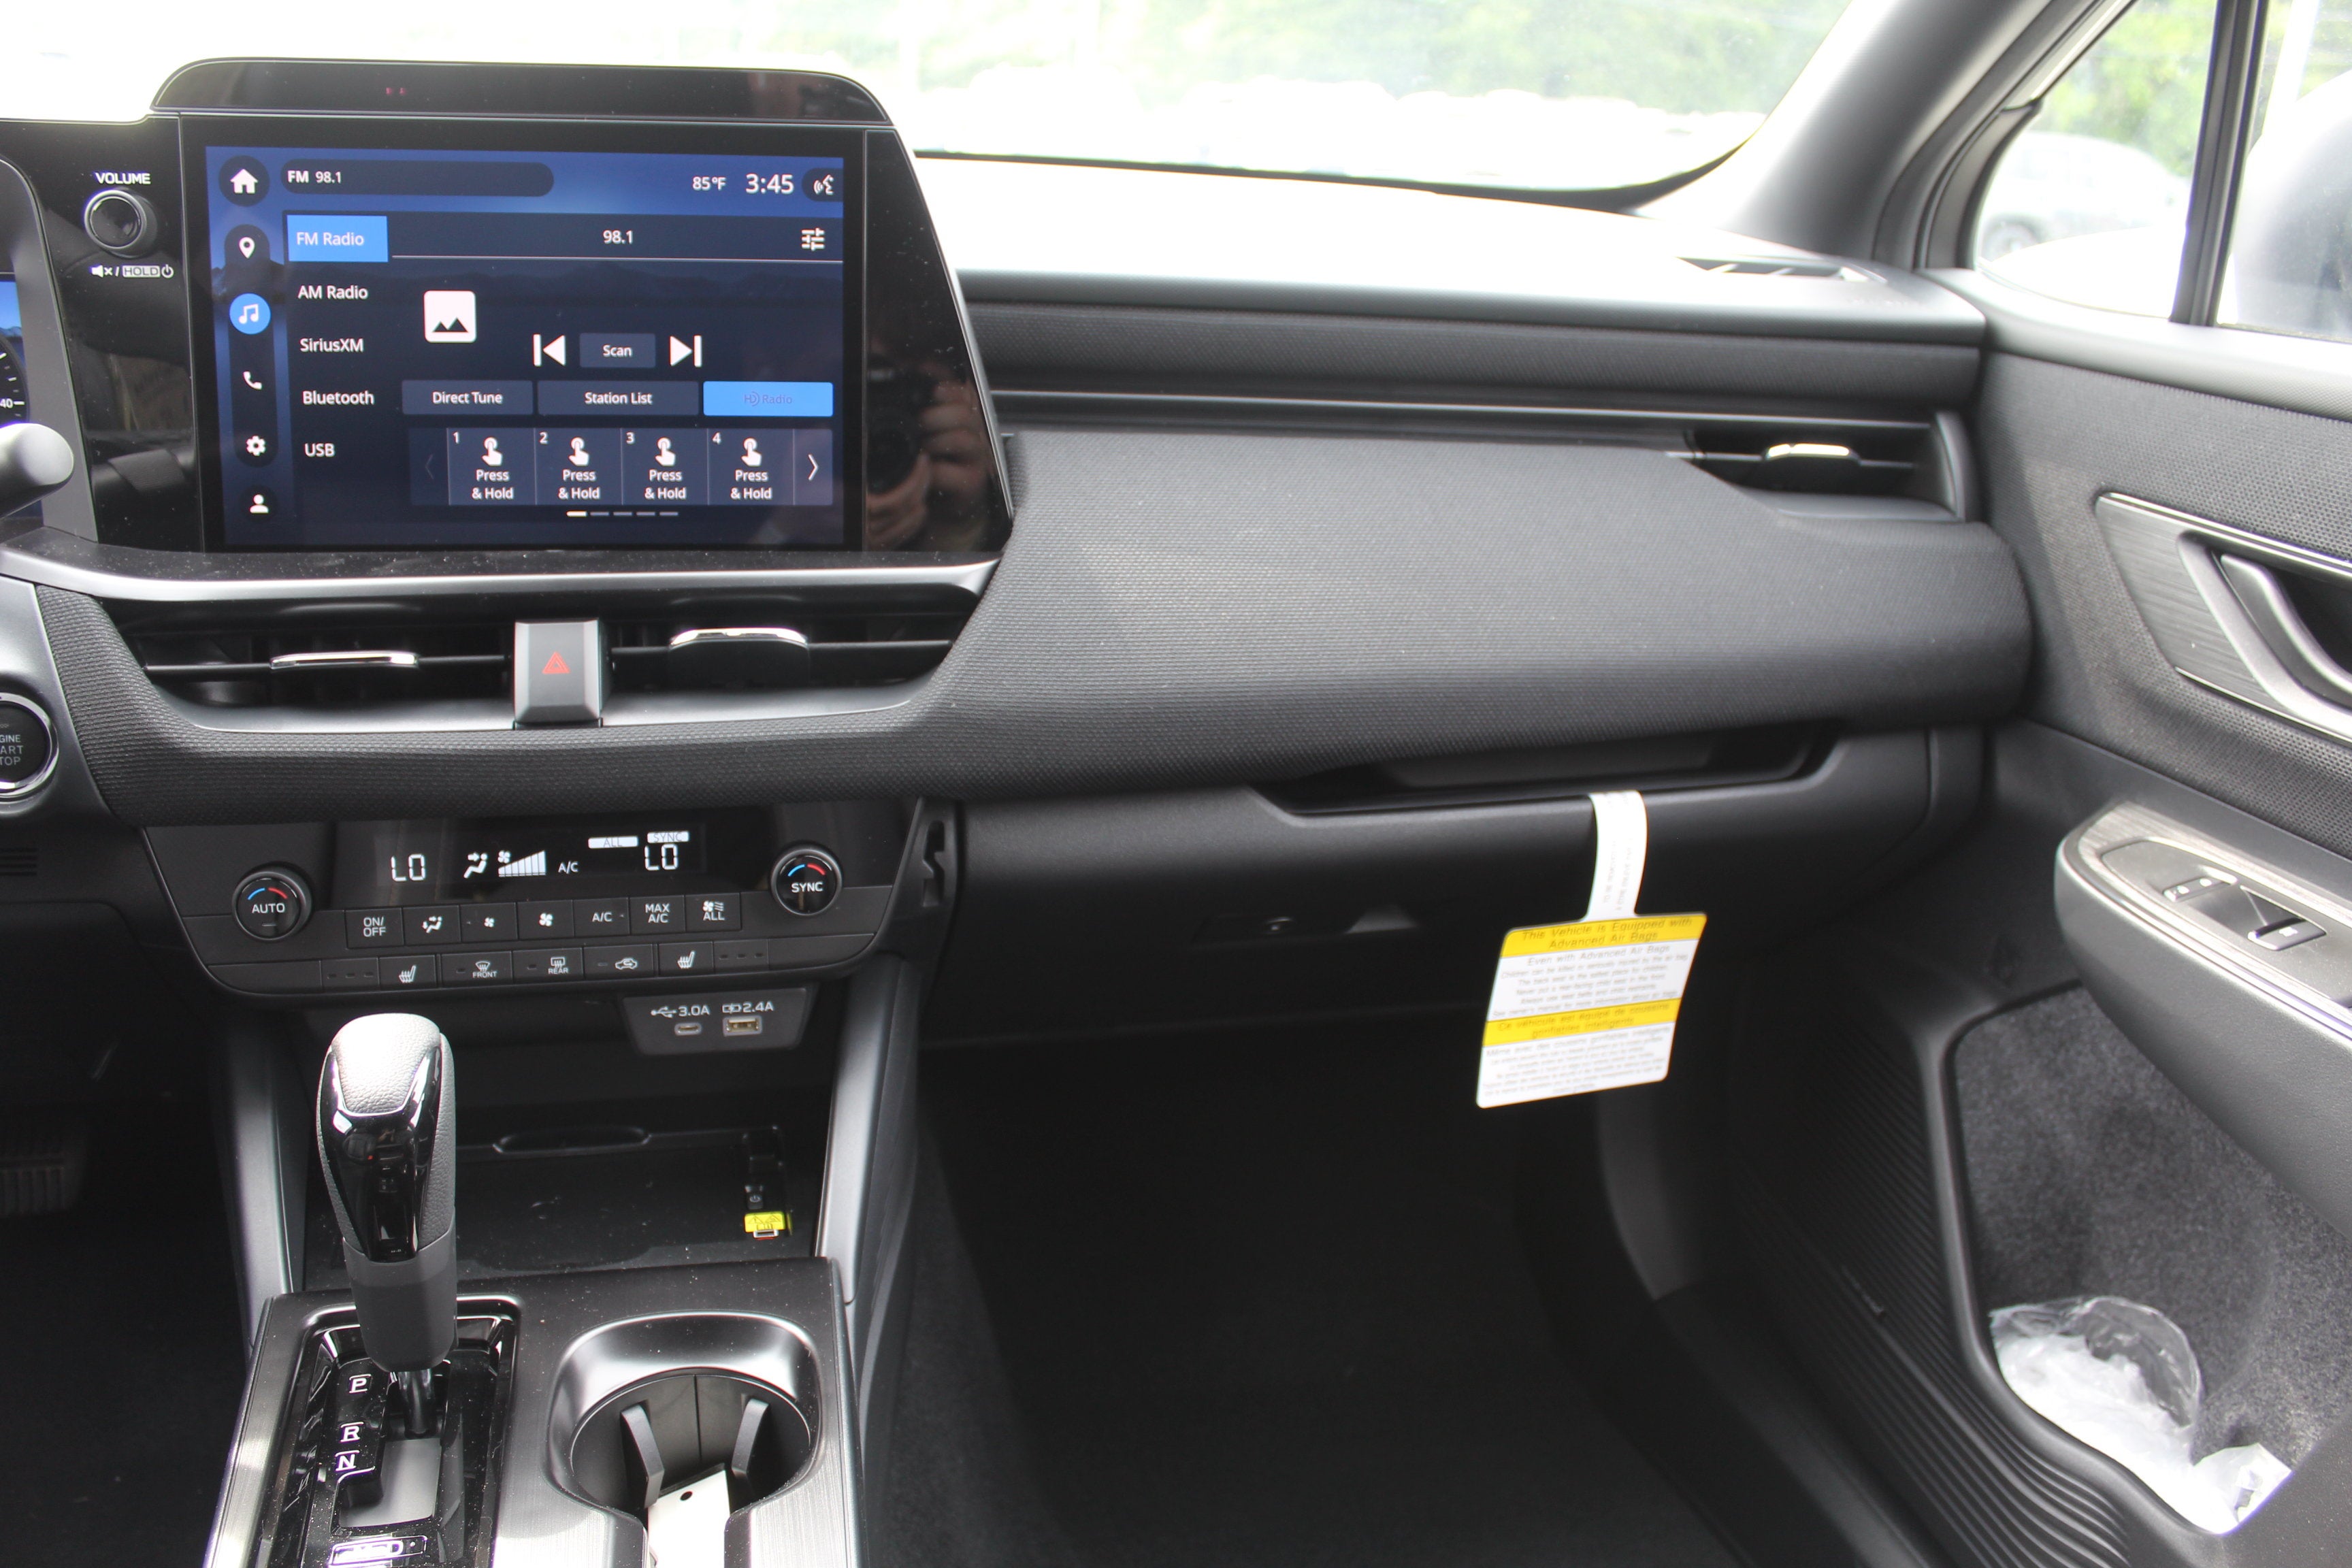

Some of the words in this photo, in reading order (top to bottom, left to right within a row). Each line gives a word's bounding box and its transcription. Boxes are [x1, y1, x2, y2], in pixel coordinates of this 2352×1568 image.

[95, 172, 151, 184] VOLUME
[287, 170, 309, 184] FM
[315, 171, 342, 184] 98.1
[692, 176, 727, 191] 85°F
[745, 173, 794, 195] 3:45
[296, 232, 318, 246] FM
[323, 231, 365, 246] Radio
[603, 229, 634, 244] 98.1
[124, 266, 159, 276] HOLD
[297, 286, 322, 299] AM
[327, 284, 368, 300] Radio
[299, 338, 364, 353] SiriusXM
[603, 344, 632, 357] Scan
[302, 391, 374, 406] Bluetooth
[433, 391, 470, 404] Direct
[472, 392, 503, 405] Tune
[585, 392, 627, 405] Station
[631, 392, 652, 405] List
[762, 394, 793, 405] Radio
[453, 431, 460, 444] 1
[539, 432, 549, 444] 2
[626, 432, 635, 444] 3
[712, 432, 721, 444] 4
[304, 443, 335, 457] USB
[476, 470, 509, 482] Press
[562, 470, 596, 482] Press
[649, 470, 683, 482] Press
[735, 470, 768, 482] Press
[472, 487, 482, 500] &
[485, 487, 514, 500] Hold
[558, 487, 569, 500] &
[571, 487, 600, 500] Hold
[644, 487, 655, 500] &
[657, 487, 687, 500] Hold
[730, 487, 740, 500] &
[743, 487, 772, 500] Hold
[653, 832, 683, 843] SYNC
[644, 843, 679, 871] LO
[391, 853, 426, 882] LO
[558, 860, 578, 874] A/C
[791, 882, 823, 893] SYNC
[252, 902, 285, 914] AUTO
[645, 903, 670, 913] MAX
[363, 917, 385, 928] ON/
[592, 912, 612, 922] A/C
[648, 913, 668, 924] A/C
[703, 911, 725, 921] ALL
[363, 927, 387, 937] OFF
[1522, 930, 1546, 941] This
[1551, 925, 1592, 937] Vehicle
[1612, 919, 1666, 932] Equipped
[1670, 917, 1693, 927] with
[1549, 935, 1606, 949] Advanced
[1611, 934, 1625, 943] Air
[1631, 932, 1659, 943] Bags
[472, 970, 497, 979] FRONT
[548, 966, 568, 975] REAR
[678, 1004, 710, 1017] 3.0A
[742, 1001, 774, 1013] 2.4A
[350, 1377, 367, 1392] P
[343, 1425, 360, 1441] R
[338, 1454, 356, 1470] N
